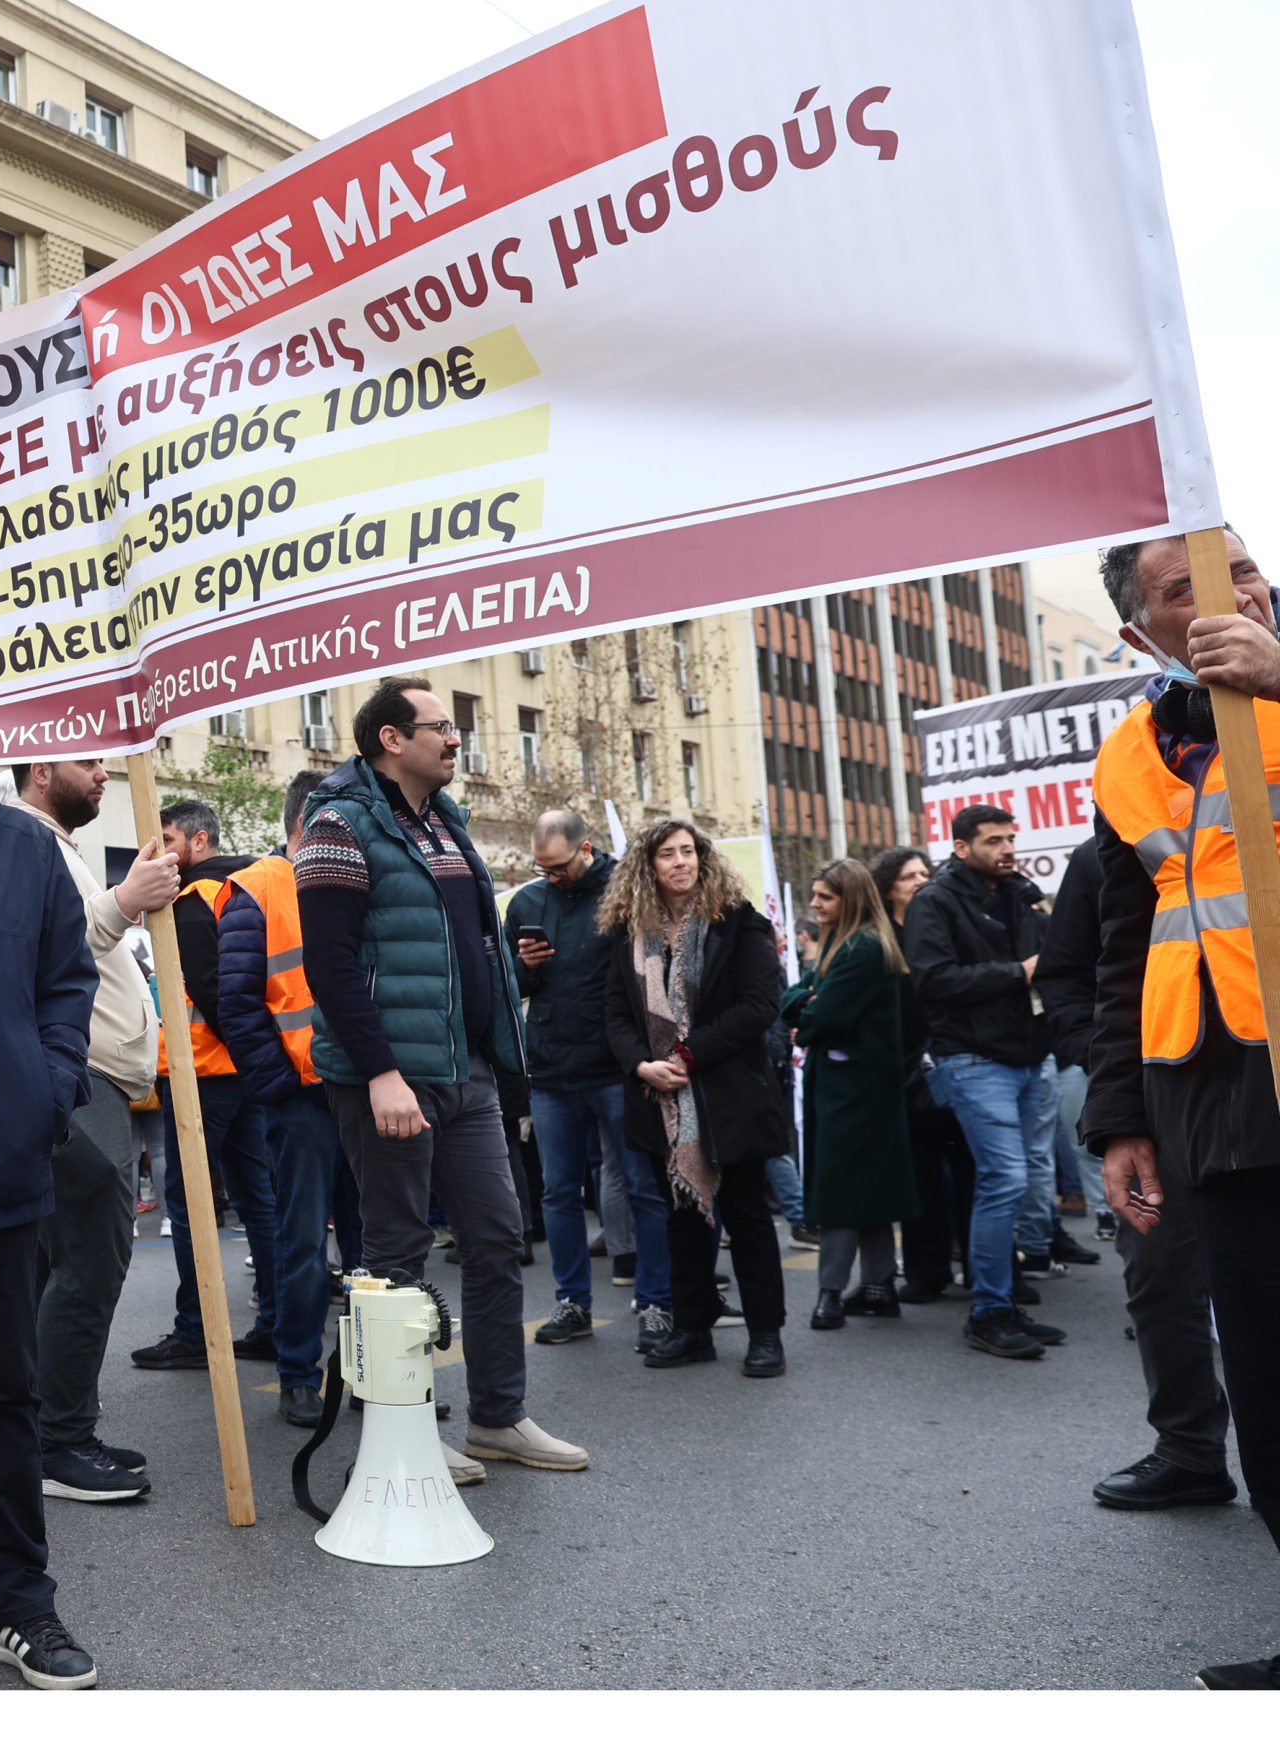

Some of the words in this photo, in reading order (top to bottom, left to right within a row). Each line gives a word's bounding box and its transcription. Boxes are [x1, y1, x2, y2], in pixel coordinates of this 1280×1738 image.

[66, 404, 107, 474] με
[117, 318, 365, 427] αυξήσεις
[363, 237, 534, 343] στους
[547, 85, 900, 290] μισθούς
[92, 308, 120, 365] ή
[141, 283, 192, 345] ΟΙ
[180, 214, 314, 324] ΖΩΕΣ
[312, 131, 467, 264] ΜΑΣ
[142, 404, 301, 500] μισθός
[322, 345, 487, 433] 1000€
[194, 512, 386, 612] εργασία
[408, 491, 520, 564] μας
[244, 614, 381, 680] Αττικής
[394, 565, 590, 649] (ΕΛΕΠΑ)
[925, 719, 1007, 777] ΕΣΕΙΣ
[1026, 778, 1094, 830] ΜΕ
[356, 1343, 364, 1383] SUPER
